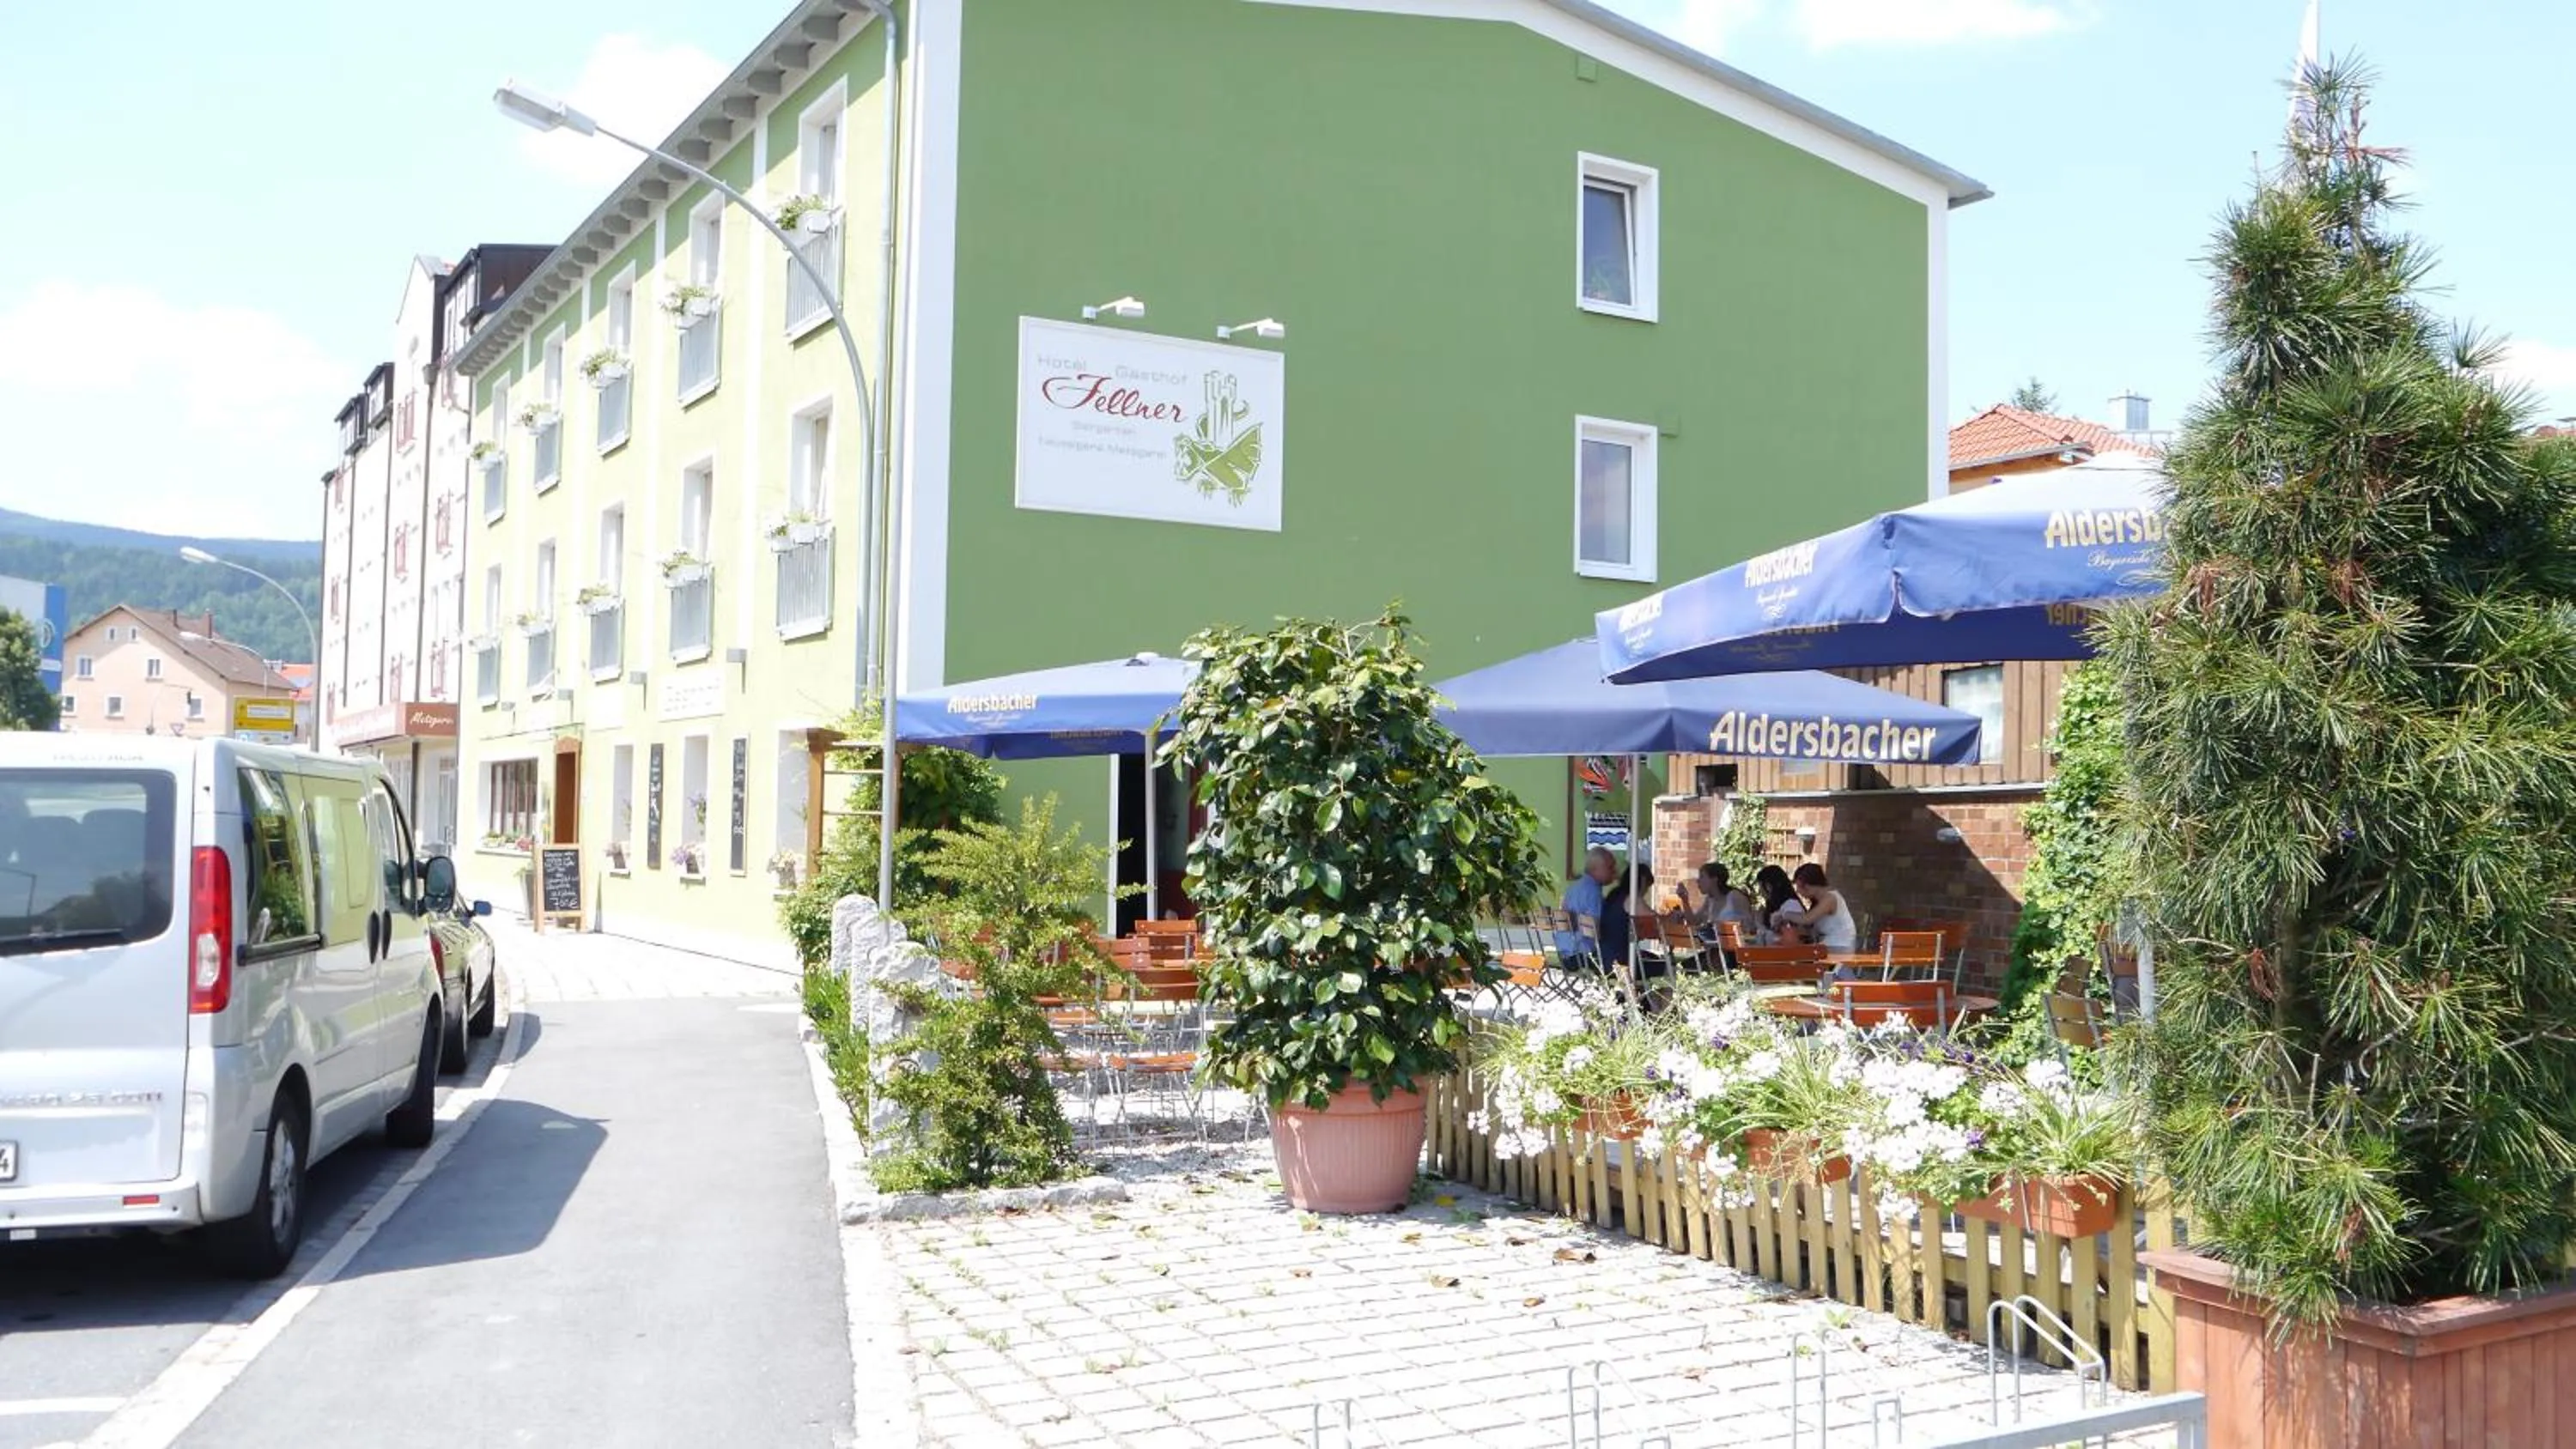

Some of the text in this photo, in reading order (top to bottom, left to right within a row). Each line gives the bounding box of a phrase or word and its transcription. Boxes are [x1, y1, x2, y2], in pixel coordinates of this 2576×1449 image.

[1037, 353, 1188, 385] Hotel Gasthof
[1041, 373, 1190, 424] Fellner
[2044, 507, 2172, 550] Aldersb
[947, 693, 1038, 714] Aldersbacher
[1710, 711, 1937, 761] Aldersbacher
